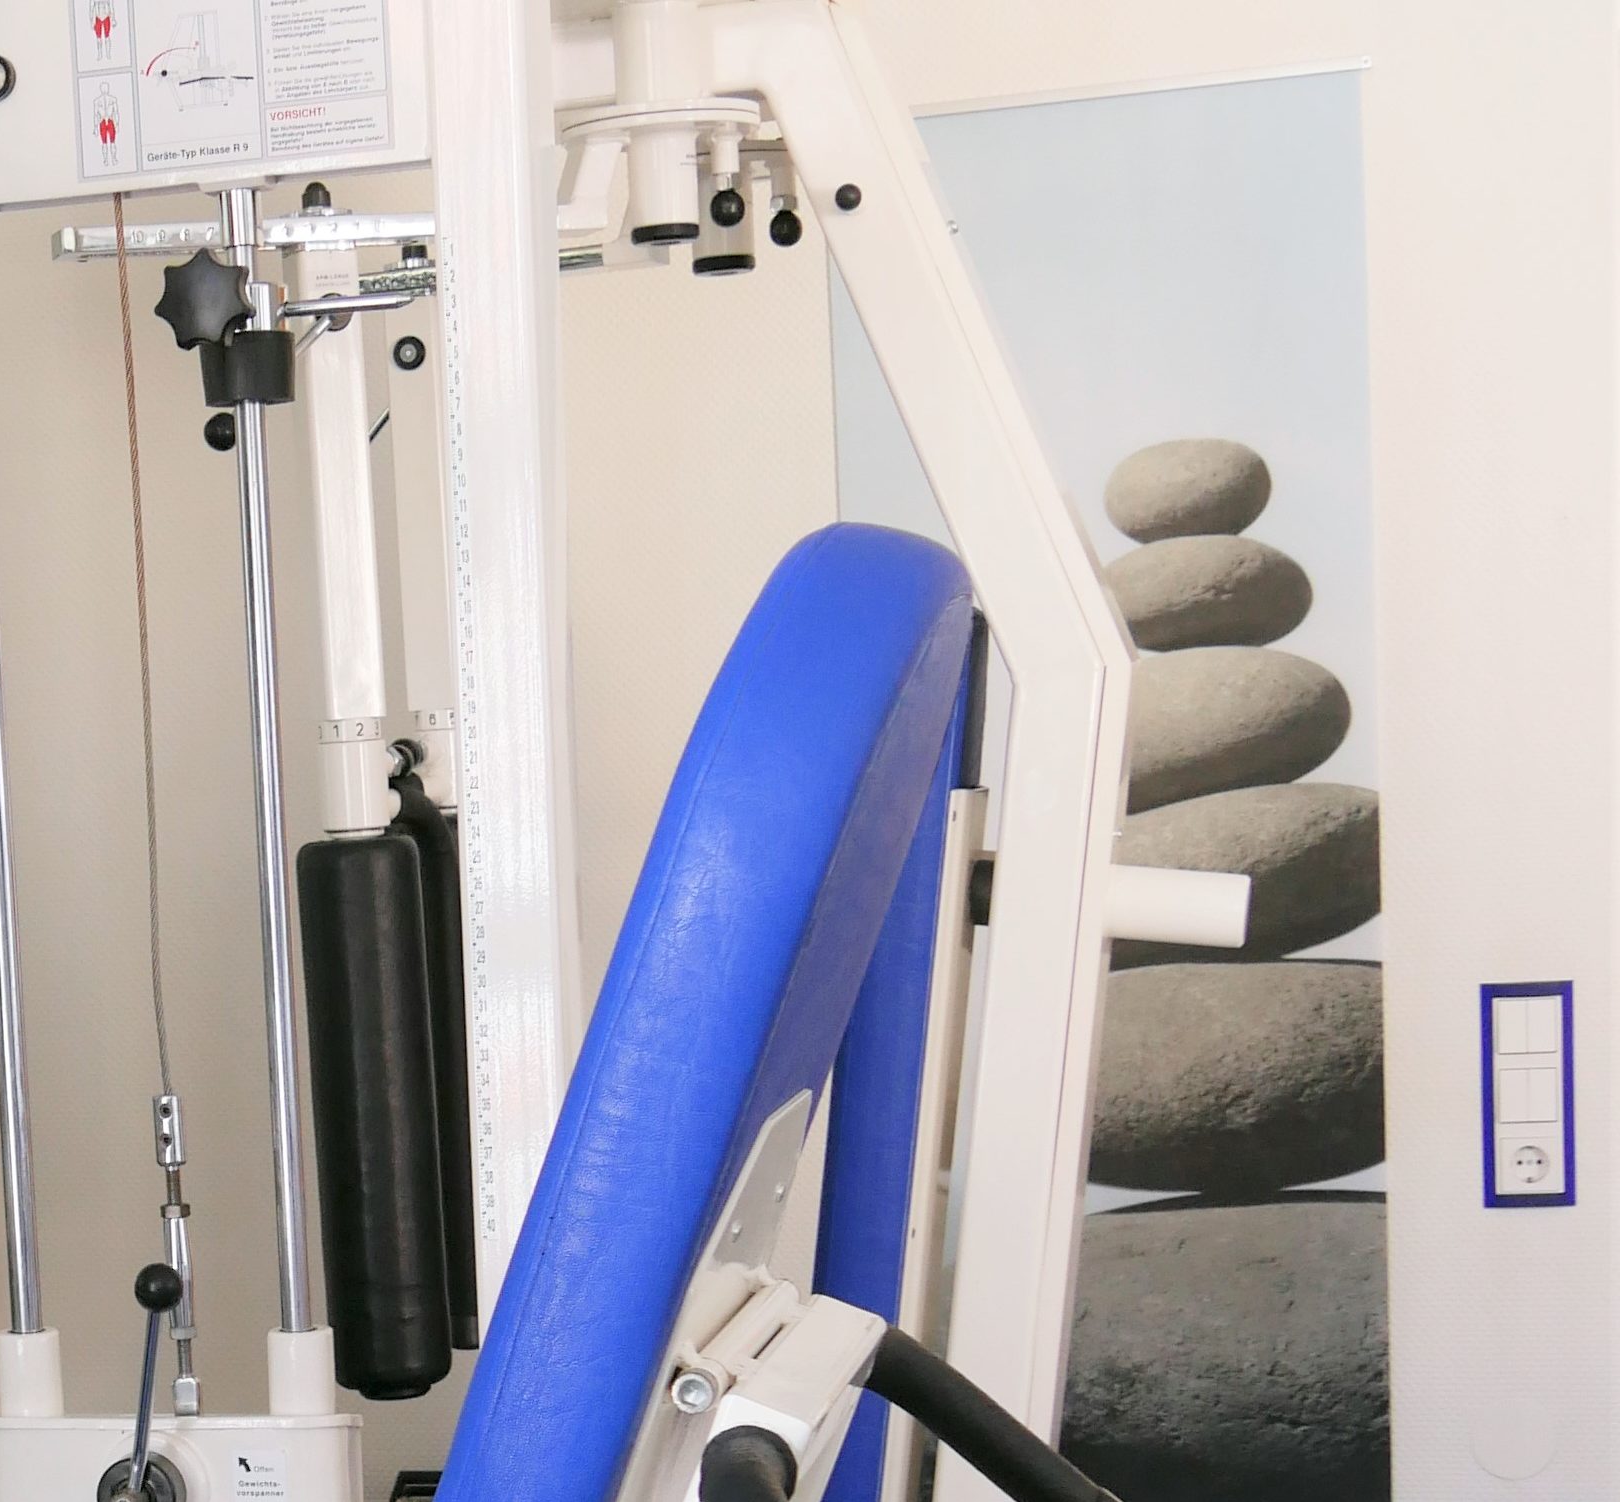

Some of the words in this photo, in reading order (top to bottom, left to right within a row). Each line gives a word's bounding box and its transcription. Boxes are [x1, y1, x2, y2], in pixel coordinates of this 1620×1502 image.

[270, 107, 326, 121] VORSICHT!
[147, 149, 197, 162] Geräte-Typ
[200, 146, 230, 156] Klasse
[233, 143, 240, 152] R
[243, 143, 249, 151] 9
[333, 725, 339, 738] 1
[356, 722, 364, 737] 2
